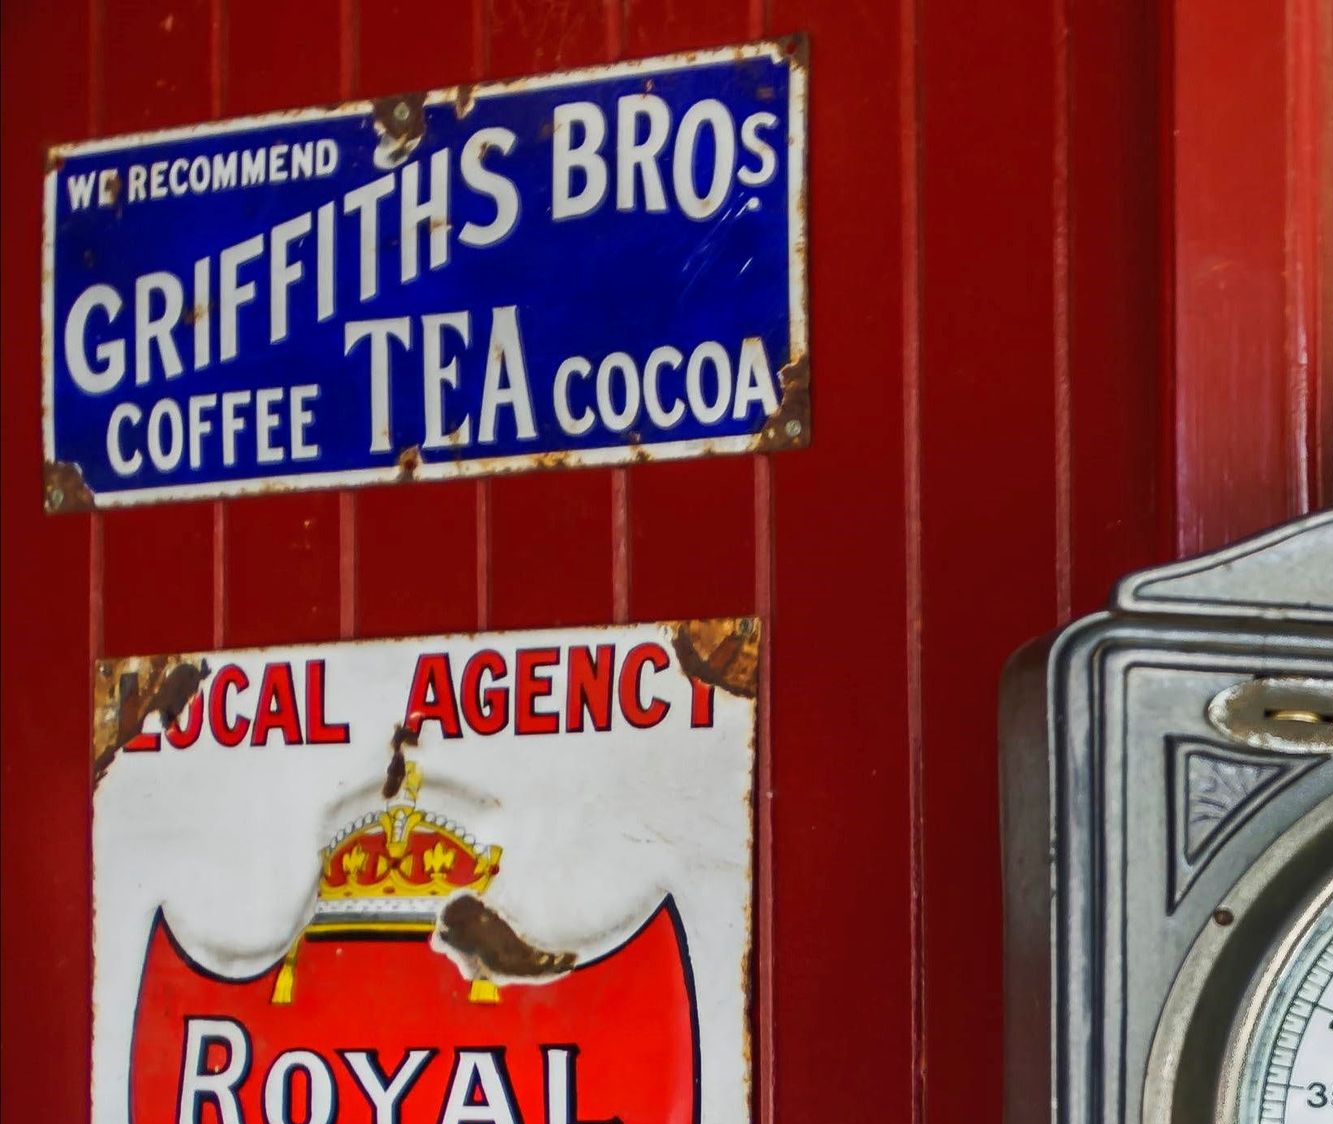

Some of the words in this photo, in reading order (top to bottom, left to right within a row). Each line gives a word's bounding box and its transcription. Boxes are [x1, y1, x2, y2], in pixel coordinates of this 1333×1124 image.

[68, 171, 118, 207] WE
[127, 138, 339, 203] RECOMMEND
[64, 126, 520, 396] GRIFFITHS
[106, 384, 321, 477] COFFEE
[343, 305, 538, 456] TEA
[553, 336, 778, 437] COCOA
[121, 660, 351, 752] OCAL
